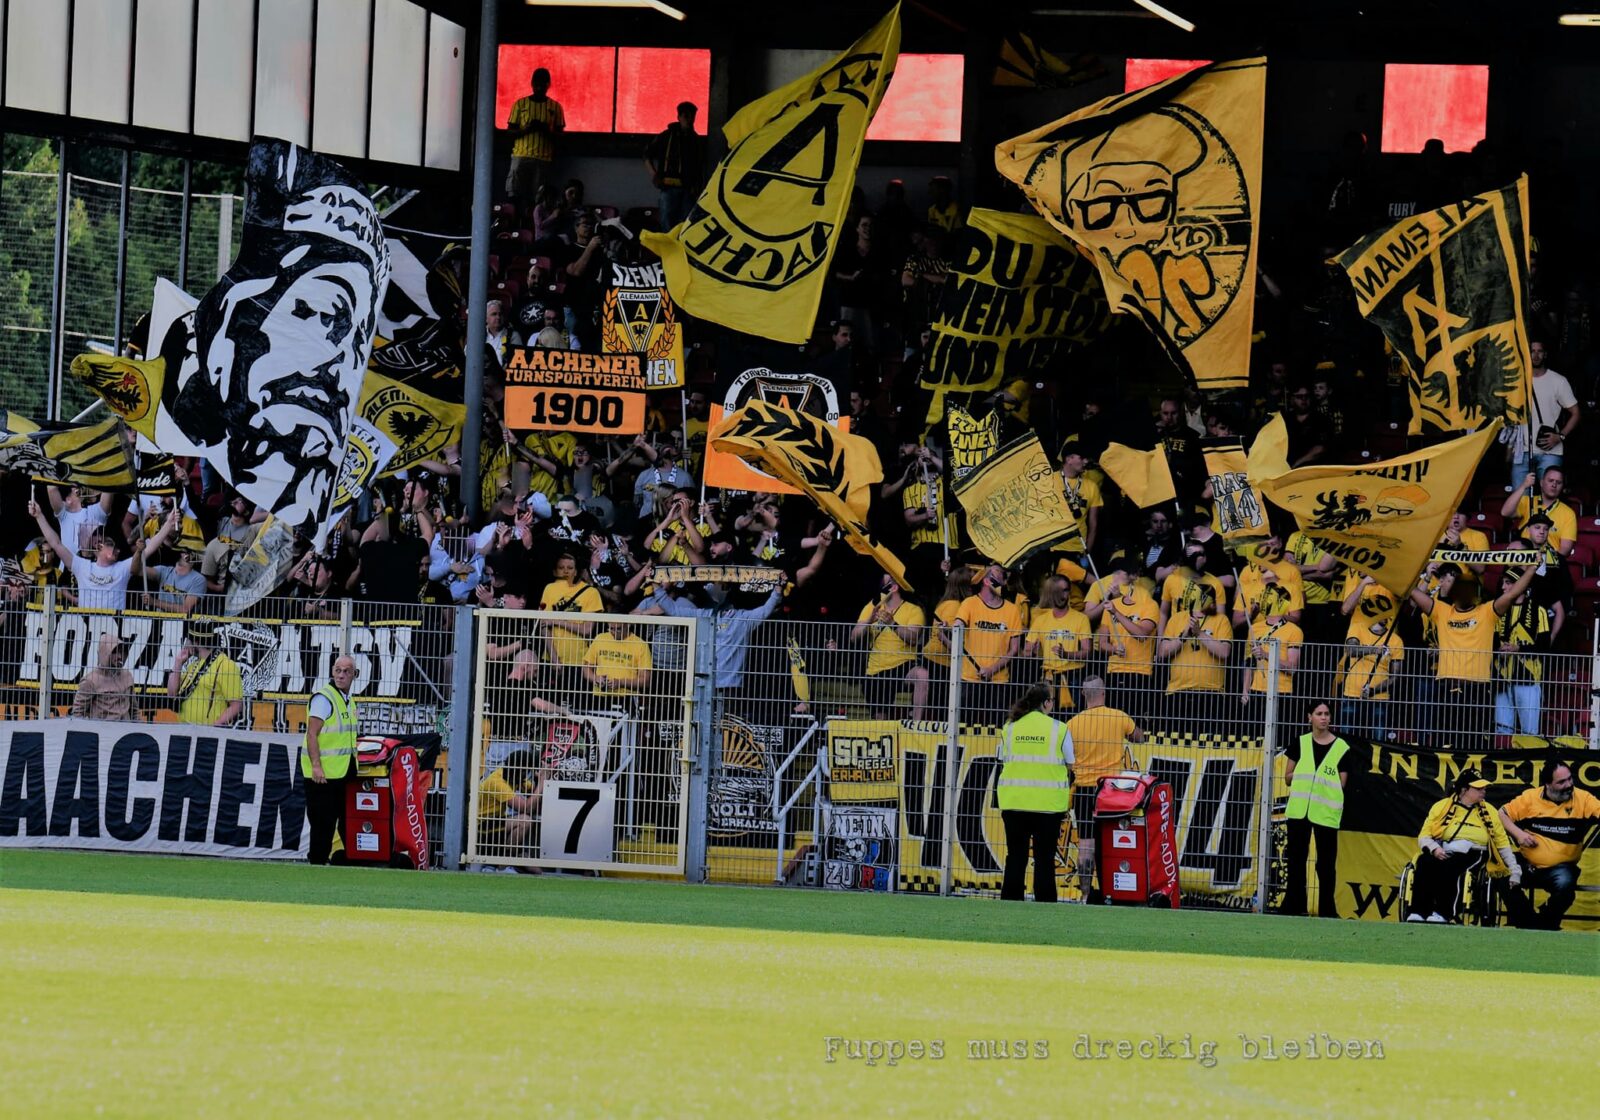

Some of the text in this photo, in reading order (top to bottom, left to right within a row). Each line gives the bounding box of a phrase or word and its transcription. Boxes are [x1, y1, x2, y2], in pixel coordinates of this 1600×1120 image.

[1387, 201, 1417, 217] FURY
[612, 262, 665, 288] SZENE
[619, 292, 660, 301] ALEMANNIA
[633, 303, 648, 320] A
[508, 349, 641, 376] AACHENER
[505, 369, 646, 390] TURNSPORTVEREIN
[531, 392, 624, 428] 1900
[724, 403, 735, 411] 19
[1442, 550, 1537, 566] CONNECTION
[228, 627, 273, 646] ALEMANNIA
[258, 625, 412, 697] ATSV
[832, 735, 894, 767] 50+1
[857, 759, 894, 770] REGEL
[1323, 764, 1337, 777] 336
[1368, 743, 1420, 784] IN
[831, 768, 895, 782] ERHALTEN!
[0, 731, 305, 850] AACHEN
[558, 787, 600, 855] 7
[721, 817, 779, 831] ERHALTEN
[833, 814, 885, 837] NEIN
[827, 862, 855, 889] ZU
[860, 864, 889, 892] RB
[1346, 881, 1399, 919] W
